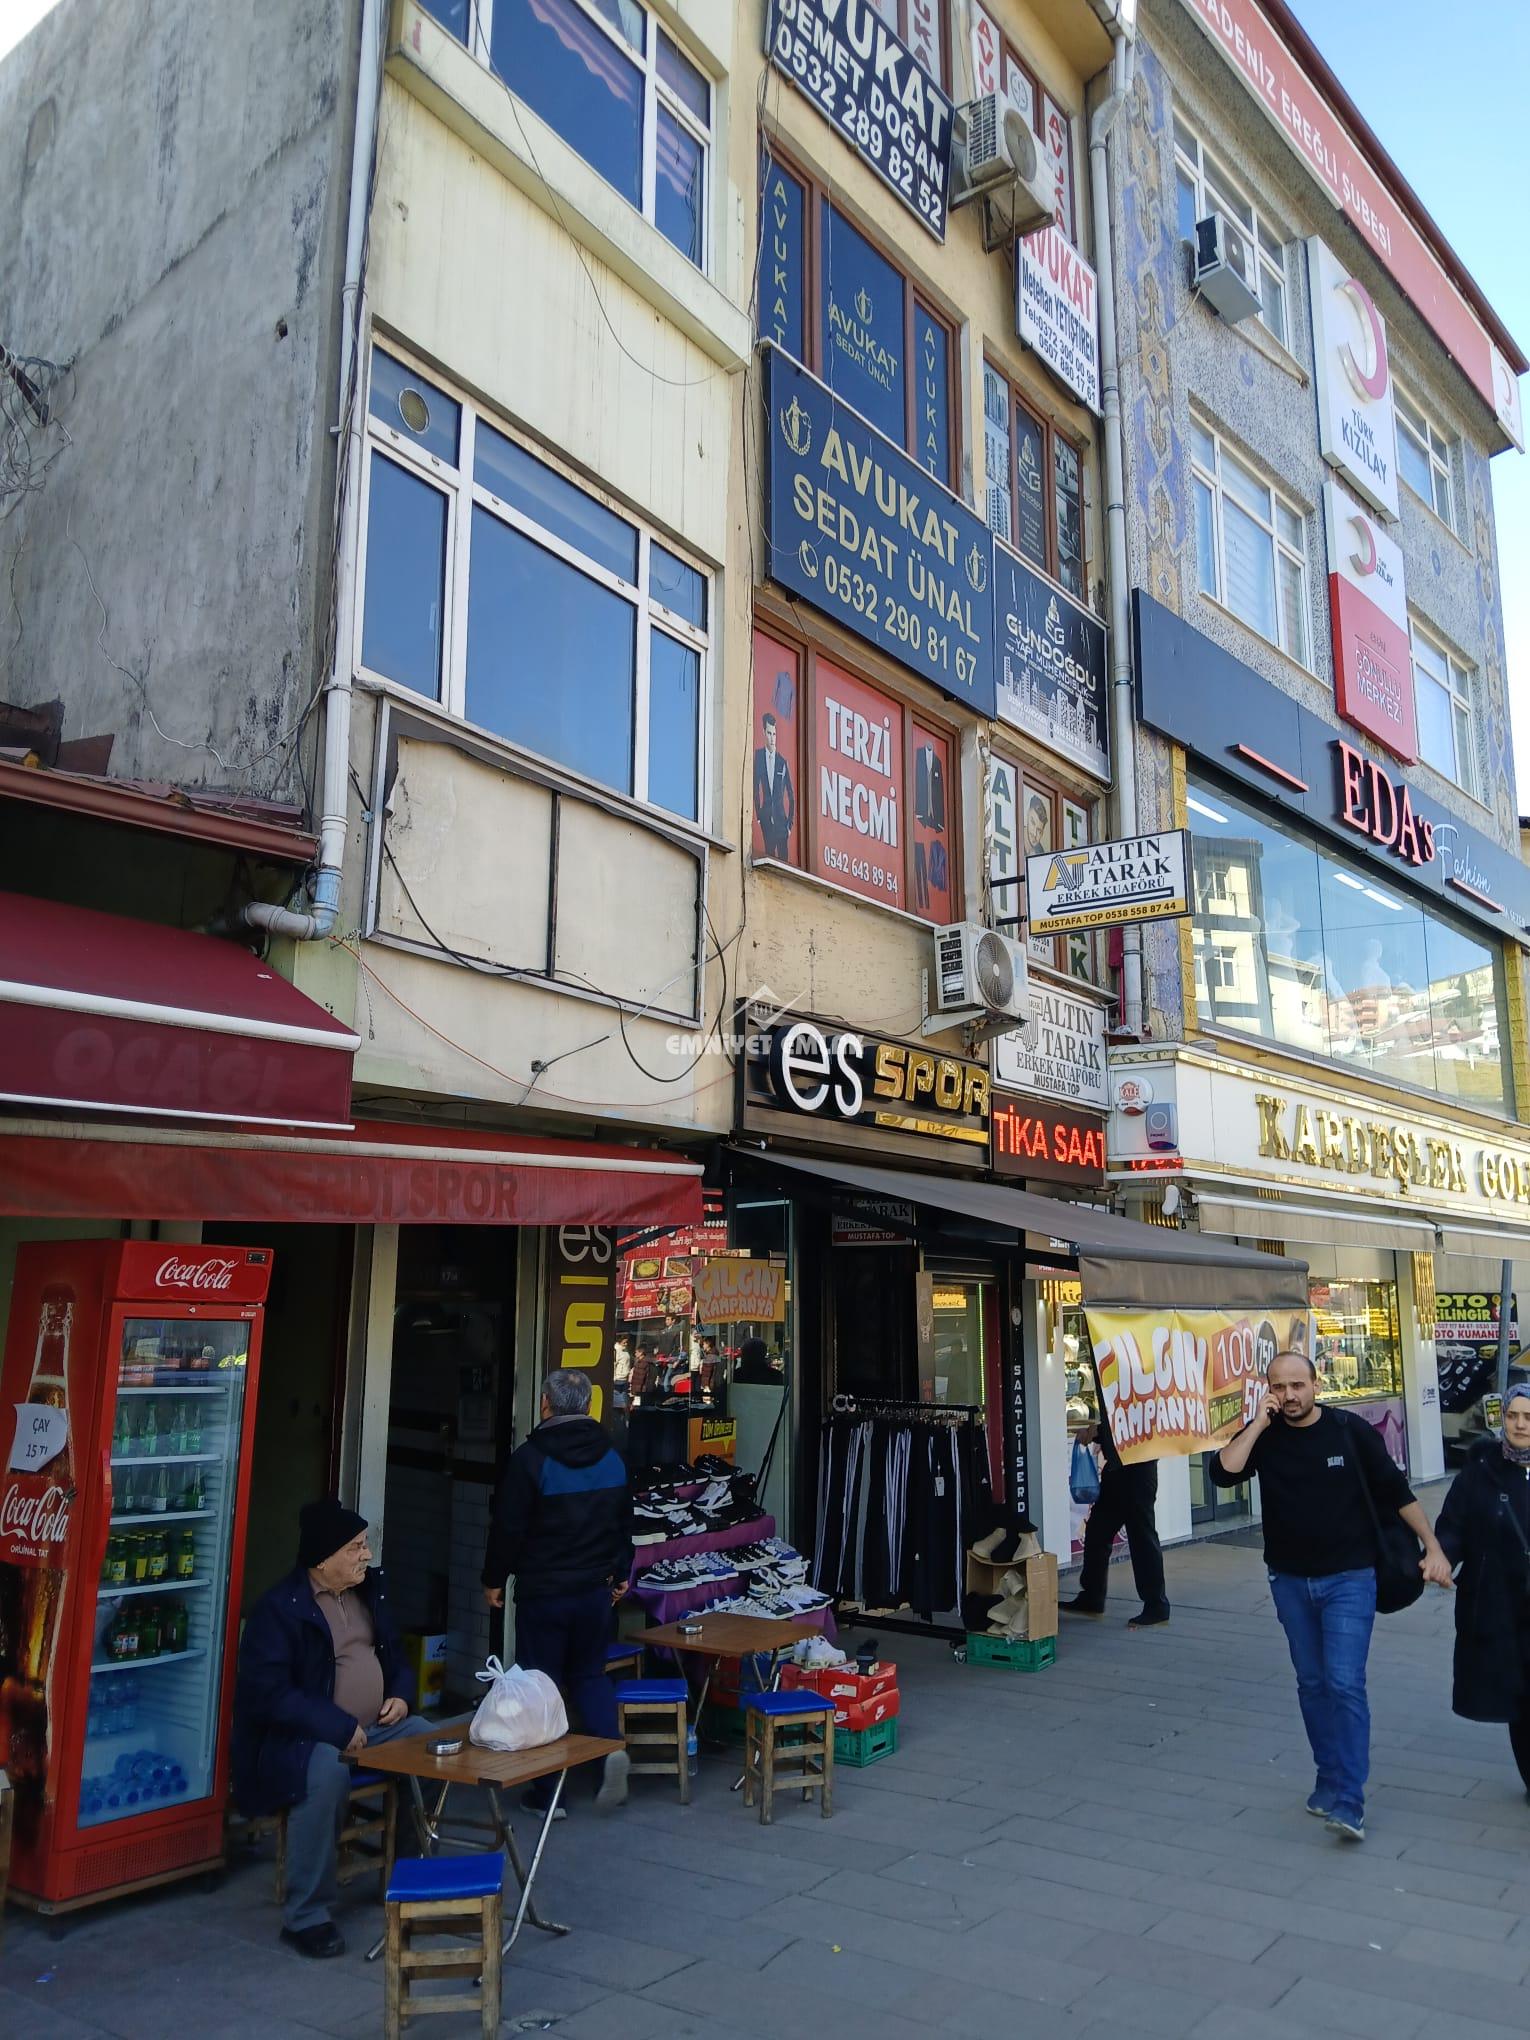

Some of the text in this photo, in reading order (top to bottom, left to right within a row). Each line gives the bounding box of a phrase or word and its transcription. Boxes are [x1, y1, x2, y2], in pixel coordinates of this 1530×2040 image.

[811, 0, 949, 149] UKAT
[777, 23, 942, 230] 0532 289 82 52
[870, 82, 943, 192] DOĞAN
[1281, 88, 1339, 185] EREĞLİ
[1342, 172, 1392, 257] ŞUBESİ
[773, 180, 788, 347] AVUKAT
[1022, 226, 1093, 323] AVUKAT
[829, 301, 898, 378] AVUKAT
[835, 331, 893, 394] SEDAT ÜNAL
[1060, 338, 1074, 361] 300
[1076, 357, 1085, 377] 00
[924, 327, 938, 476] AVUKAT
[1076, 374, 1085, 393] 17
[1341, 417, 1388, 486] KIZILAY
[1351, 408, 1375, 446] TÜRK
[820, 427, 959, 567] AVUKAT
[792, 473, 899, 581] SEDAT
[907, 549, 981, 643] ÜNAL
[824, 555, 878, 624] 0532
[885, 598, 921, 651] 290
[927, 627, 948, 671] 81
[955, 646, 977, 687] 67
[1045, 615, 1065, 646] EG
[1006, 612, 1097, 692] GÜNDOĞDU
[1354, 649, 1402, 701] GÖNÜLLÜ
[1355, 672, 1404, 726] MERKEZİ
[825, 697, 891, 780] TERZİ
[821, 765, 898, 849] NECMİ
[824, 845, 899, 894] 0542 643 89 54
[1089, 855, 1172, 886] TARAK
[1090, 837, 1161, 866] ALTIN
[1433, 823, 1492, 894] Fashion
[1040, 901, 1176, 929] MUSTAFA TOP 0538 558 87 44
[1057, 875, 1166, 904] ERKEK KUAFÖRÜ
[1042, 996, 1094, 1038] ALTIN
[781, 1023, 990, 1117] es SPOR
[1016, 1051, 1101, 1089] ERKEK KUAFÖRÜ
[1042, 1027, 1101, 1071] TARAK
[1033, 1074, 1080, 1096] MUSTAFA TOP
[994, 1104, 1105, 1169] TİKA SAAT
[1255, 1093, 1468, 1194] KARDEŞLER
[409, 1166, 518, 1220] SPOR
[847, 1232, 880, 1240] MUSTAFA
[1436, 1294, 1488, 1308] OTO
[1435, 1330, 1454, 1339] OTO
[26, 1443, 37, 1458] 15
[32, 1418, 50, 1434] ÇAY
